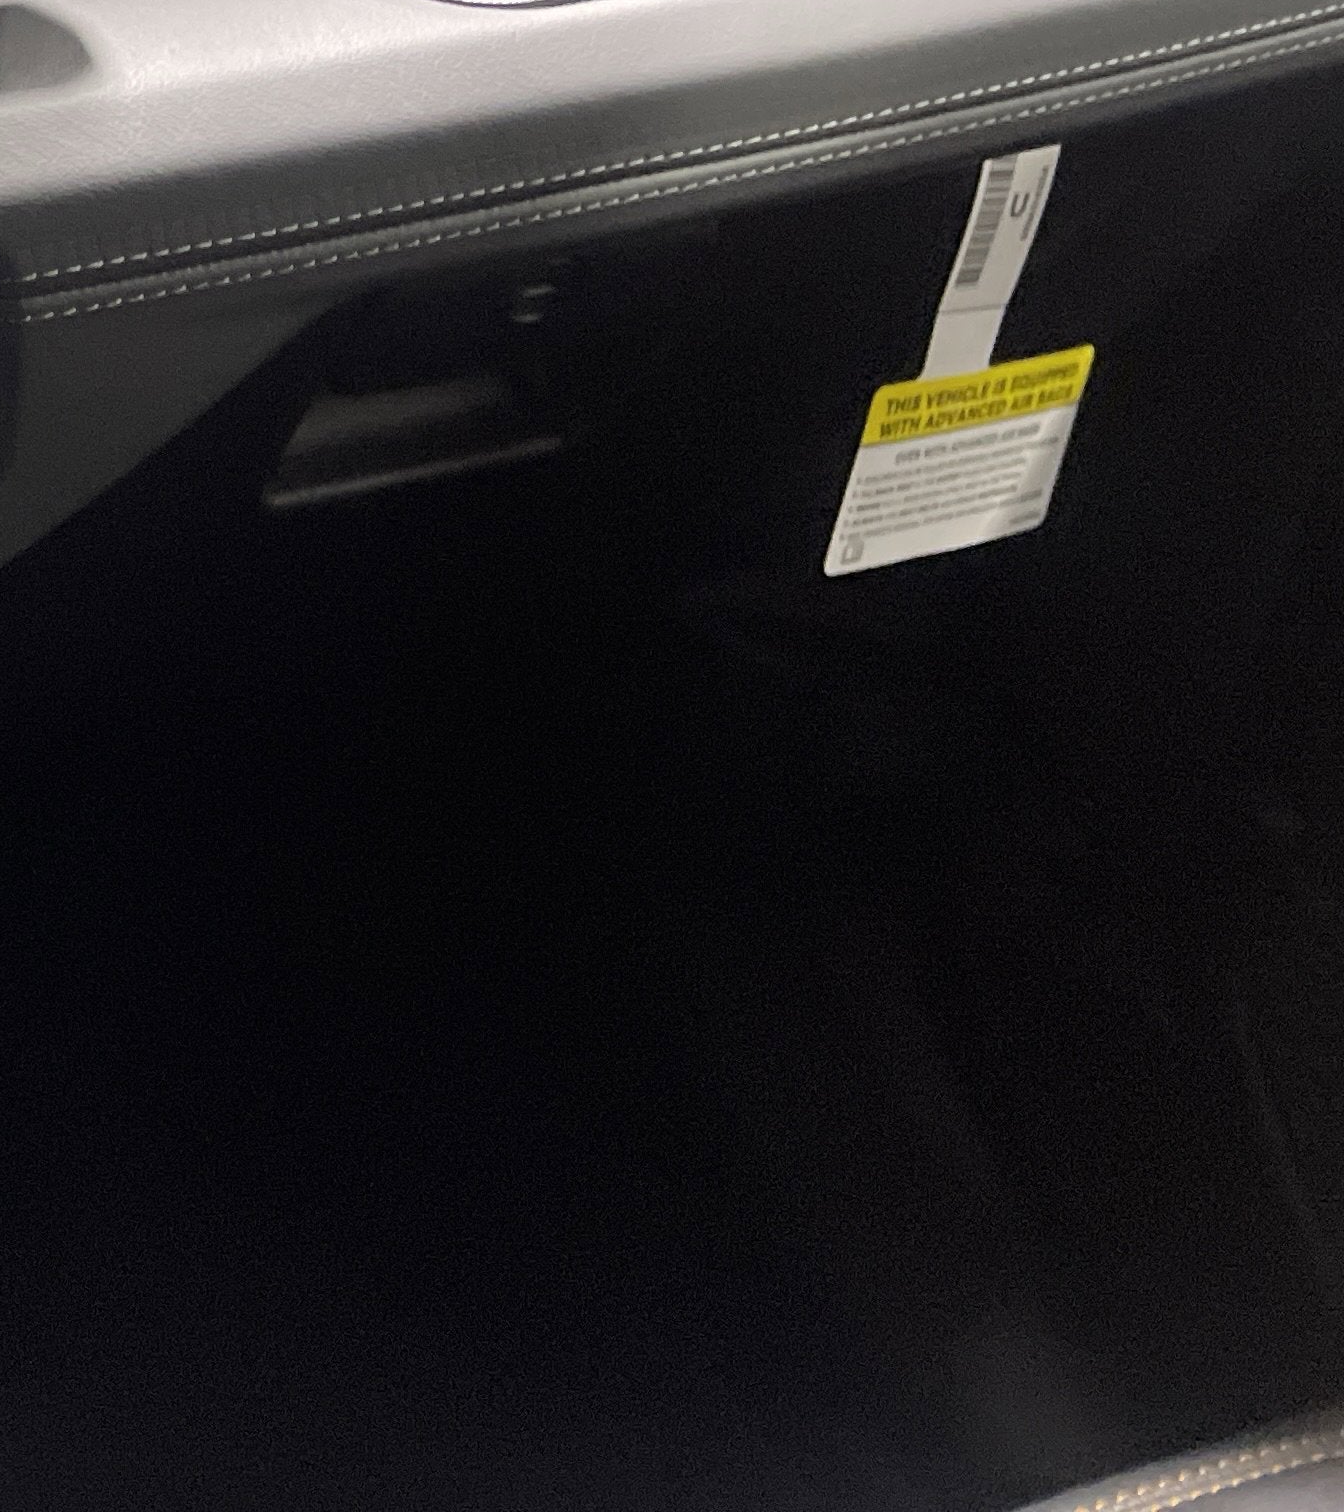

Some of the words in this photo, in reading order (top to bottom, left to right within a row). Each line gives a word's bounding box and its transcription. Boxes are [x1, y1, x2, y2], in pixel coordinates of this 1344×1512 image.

[886, 394, 922, 416] THIS
[926, 379, 991, 409] VEHICLE
[879, 416, 922, 438] WITH
[925, 399, 1009, 430] ADVANCED
